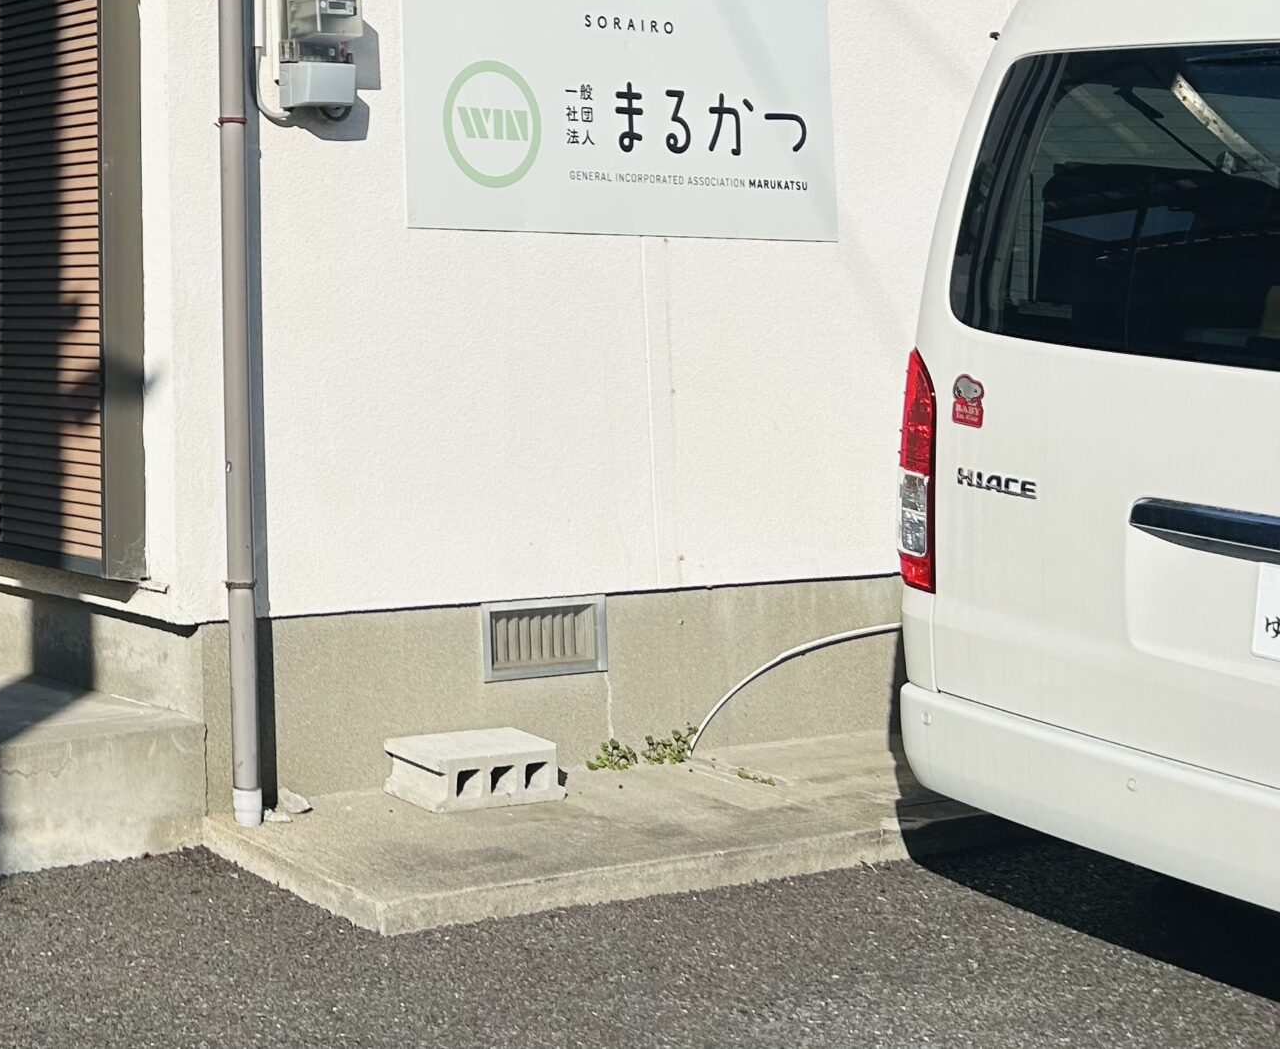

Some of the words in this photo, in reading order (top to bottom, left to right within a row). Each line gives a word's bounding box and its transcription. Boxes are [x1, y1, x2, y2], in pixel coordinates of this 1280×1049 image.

[584, 14, 675, 35] SORAIRO
[565, 83, 593, 101] 一般
[456, 106, 529, 141] WIN
[565, 105, 593, 123] 社団
[615, 81, 807, 156] まるかつ
[566, 128, 595, 146] 法人
[569, 169, 612, 183] GENERAL
[615, 172, 685, 187] INCORPORATED
[687, 176, 746, 189] ASSOCIATION
[748, 179, 808, 191] MARUKATSU
[957, 467, 1037, 500] HIACE
